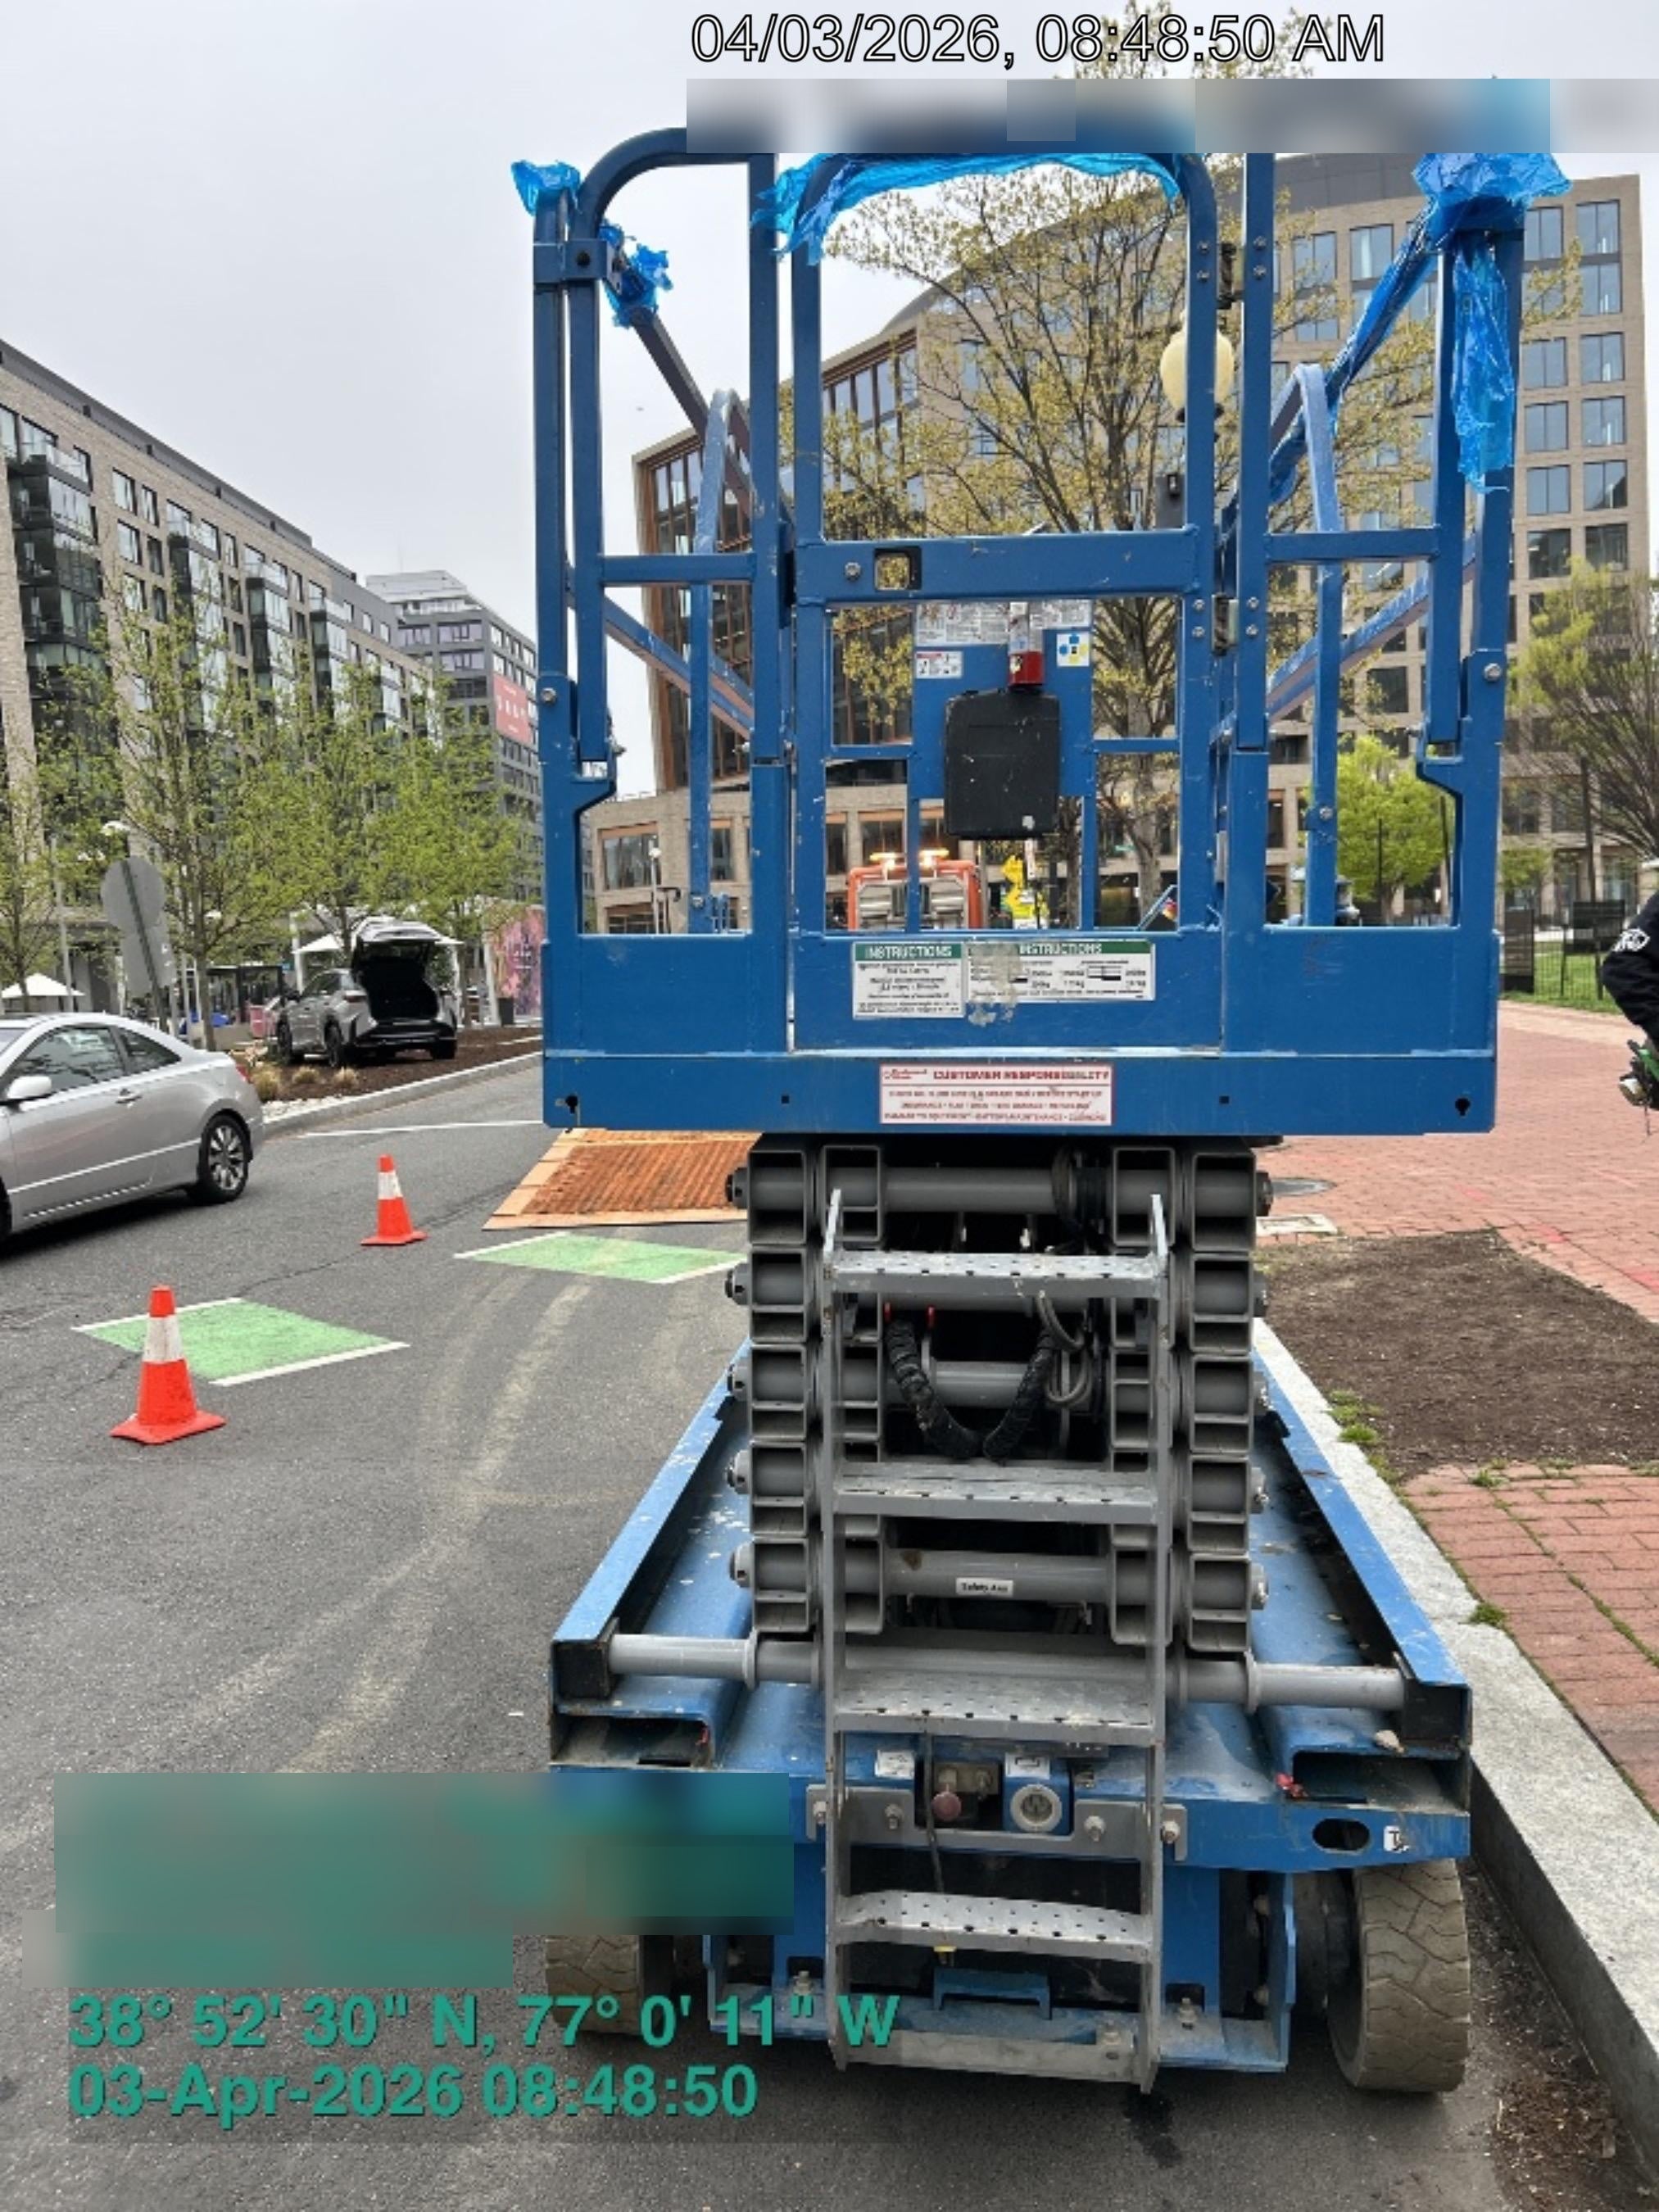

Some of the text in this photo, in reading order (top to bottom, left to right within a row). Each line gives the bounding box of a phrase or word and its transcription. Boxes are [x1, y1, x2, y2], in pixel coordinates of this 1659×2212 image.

[864, 945, 952, 959] INSTRUCTIONS
[1019, 943, 1102, 954] INSTRUCTIONS
[933, 1070, 1001, 1080] CUSTOMER
